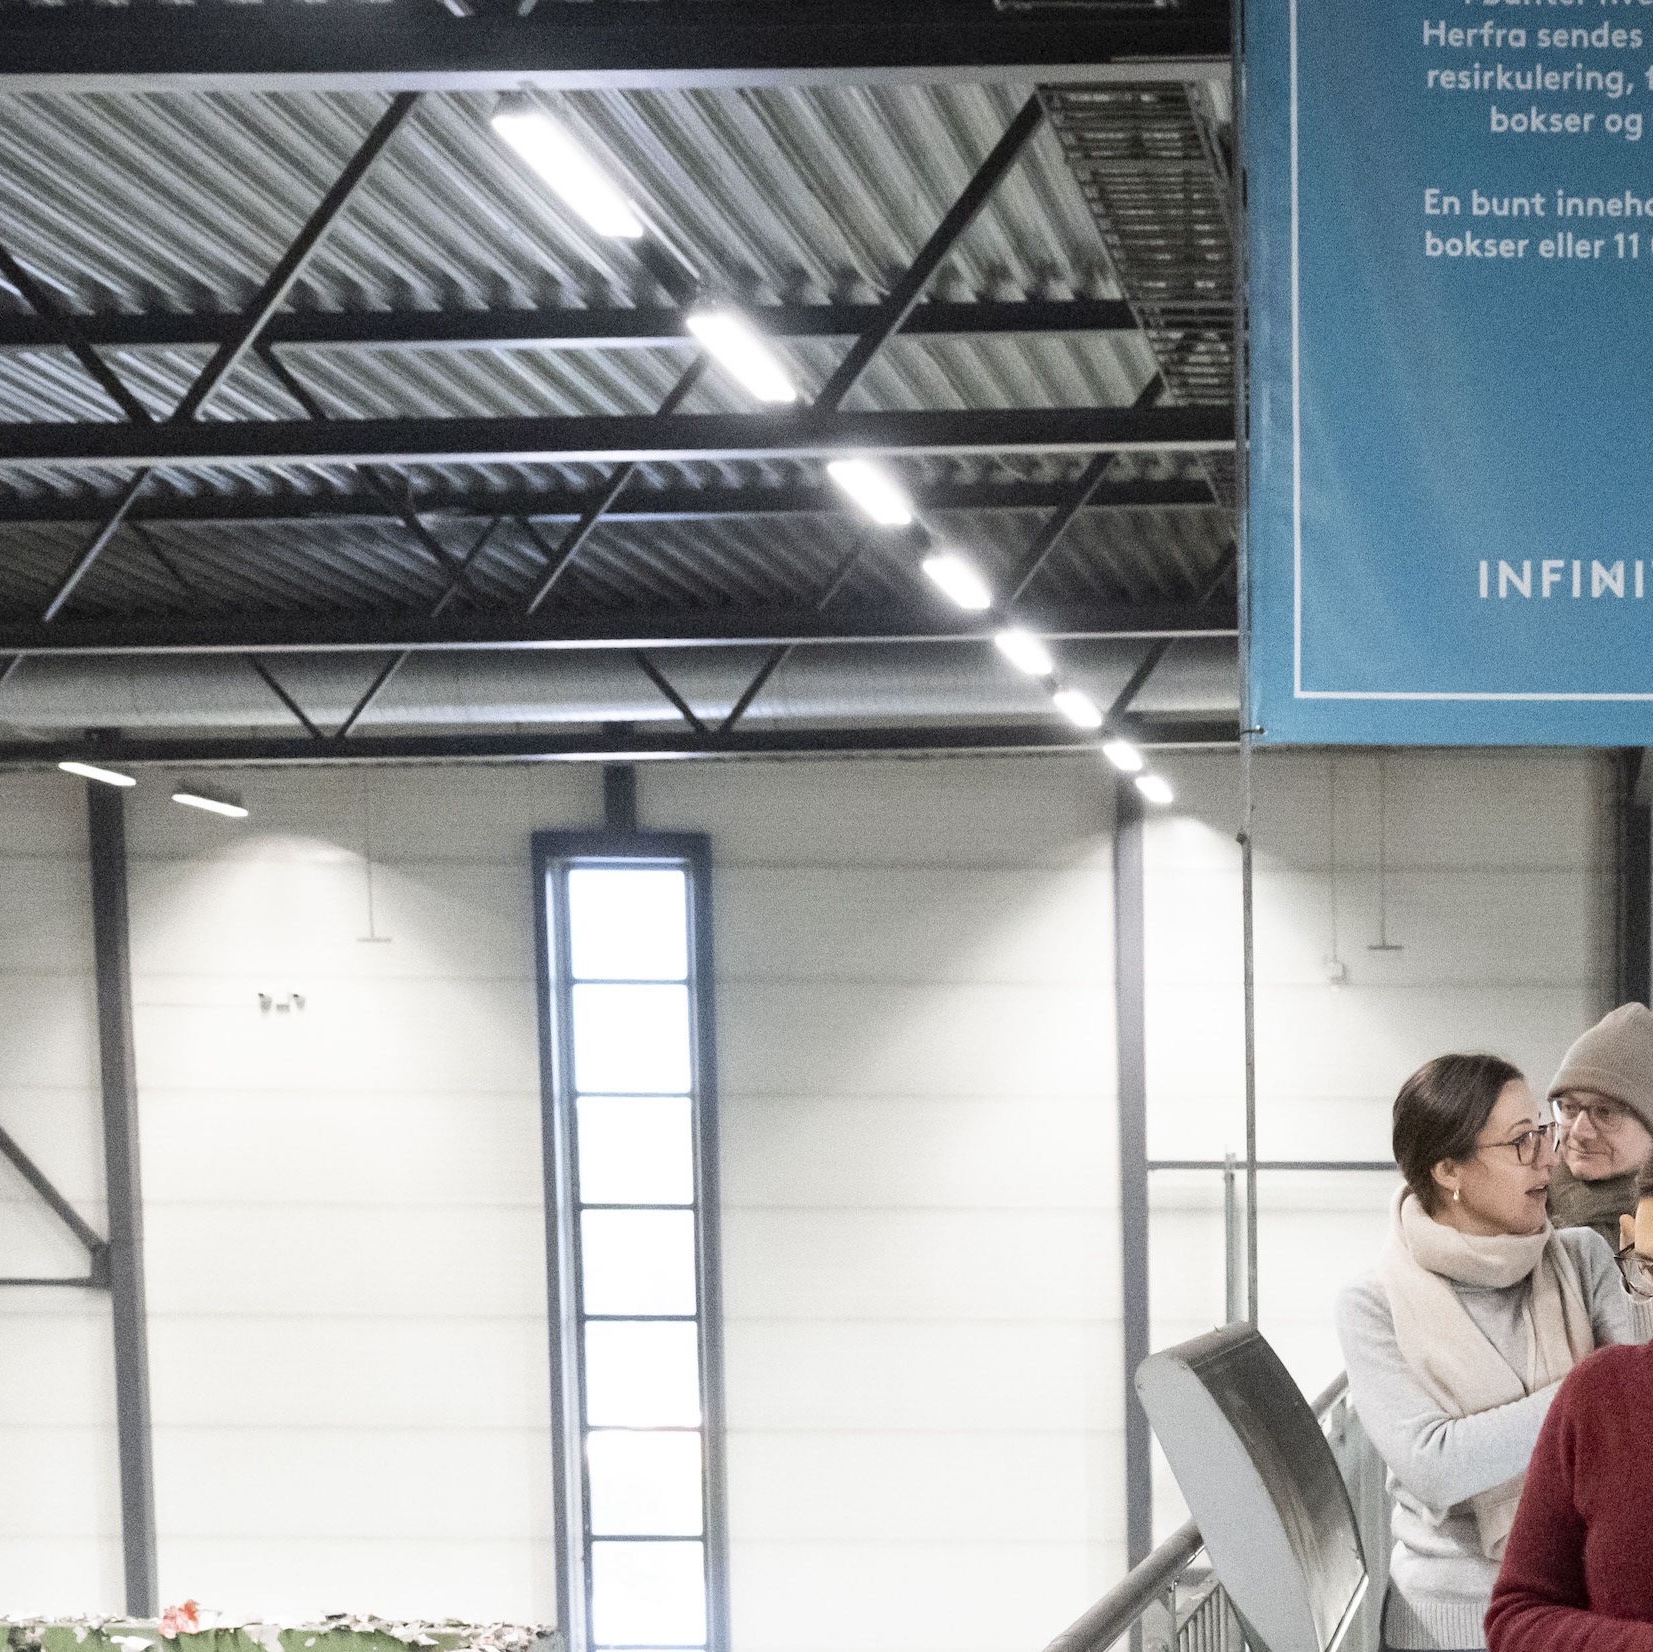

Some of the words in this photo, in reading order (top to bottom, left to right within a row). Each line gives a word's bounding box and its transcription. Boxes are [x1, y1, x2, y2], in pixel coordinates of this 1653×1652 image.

[1422, 20, 1526, 48] Herfra
[1538, 21, 1642, 48] sendes
[1426, 63, 1634, 98] resirkulering,
[1490, 105, 1595, 133] bokser
[1604, 113, 1643, 141] og
[1424, 188, 1461, 215] En
[1472, 188, 1546, 217] bunt
[1425, 231, 1529, 259] bokser
[1539, 231, 1605, 259] eller
[1615, 232, 1639, 258] 11
